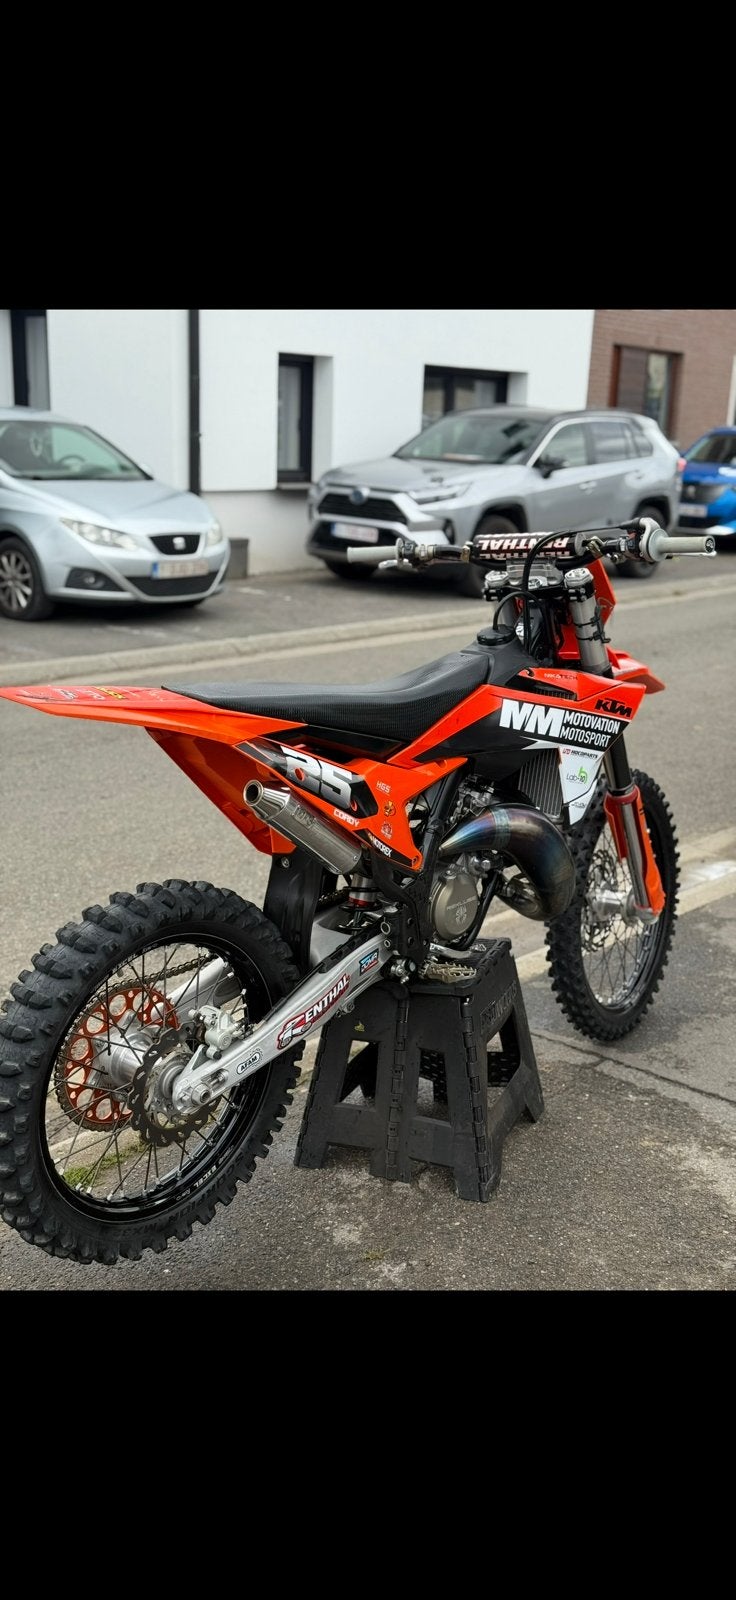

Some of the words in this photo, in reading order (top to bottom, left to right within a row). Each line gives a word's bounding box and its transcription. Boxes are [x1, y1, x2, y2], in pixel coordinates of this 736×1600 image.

[499, 698, 565, 738] MM
[595, 698, 632, 717] KTM
[563, 711, 620, 735] MOTOVATION
[559, 726, 611, 748] MOTOSPORT
[376, 780, 391, 794] HGS
[333, 808, 360, 828] CORDY
[278, 975, 349, 1049] RENTHAL
[240, 1054, 258, 1071] AFAM
